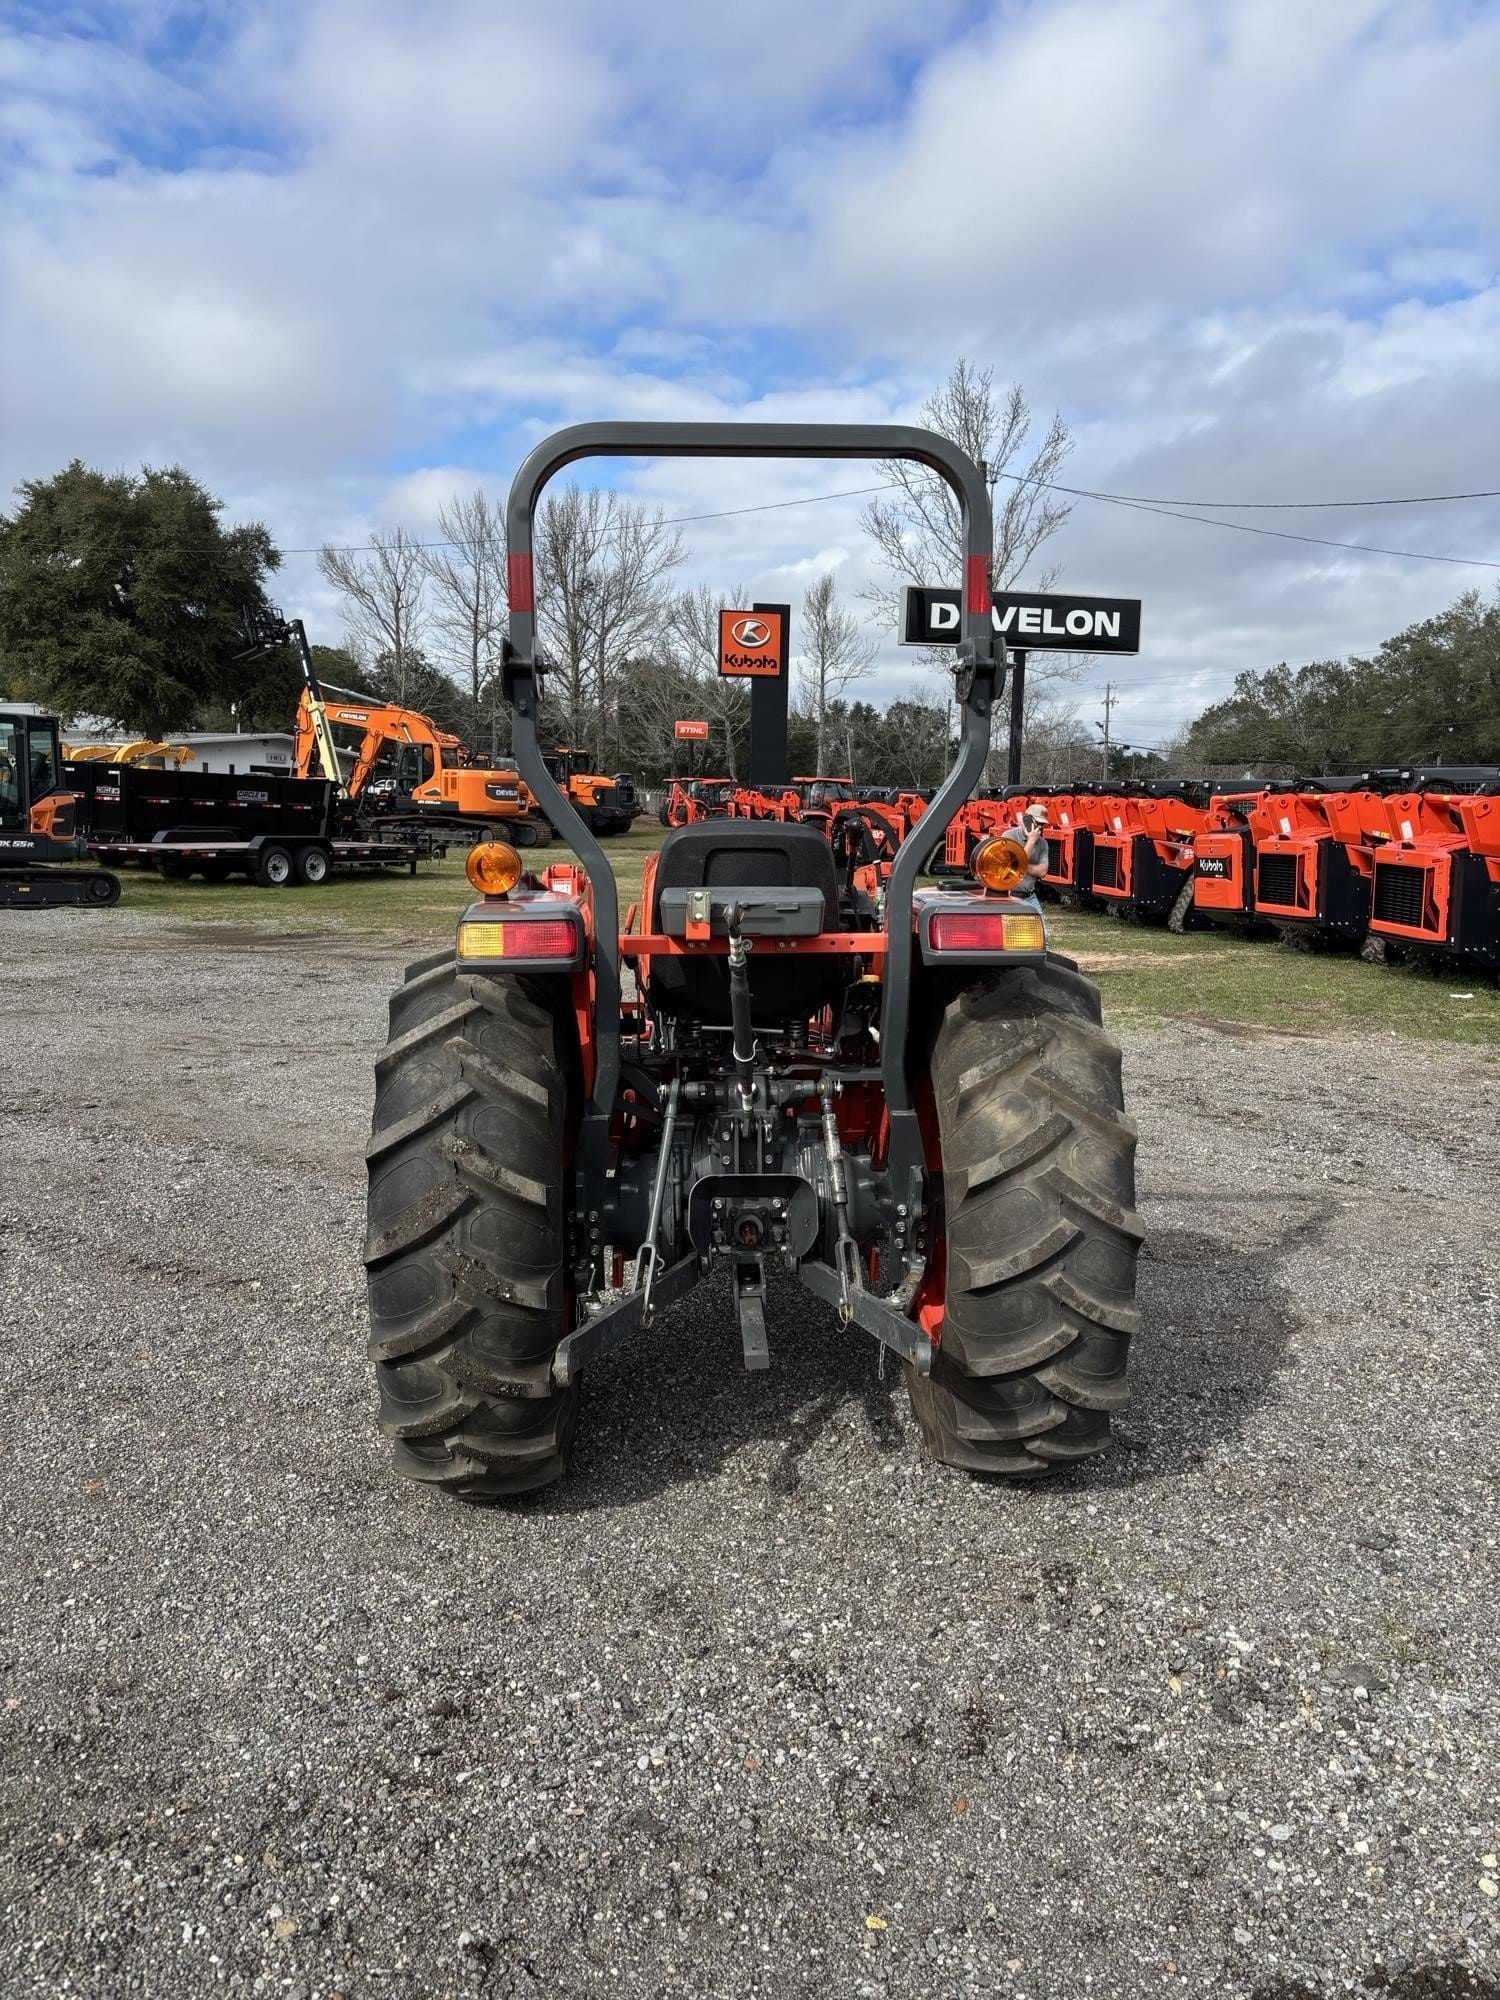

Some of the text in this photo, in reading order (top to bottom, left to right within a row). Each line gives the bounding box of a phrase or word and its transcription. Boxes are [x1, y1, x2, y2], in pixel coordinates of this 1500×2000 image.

[930, 602, 1121, 638] DVELON
[724, 653, 778, 669] Kubota
[679, 726, 705, 735] STIHL
[1199, 859, 1224, 872] Kubota
